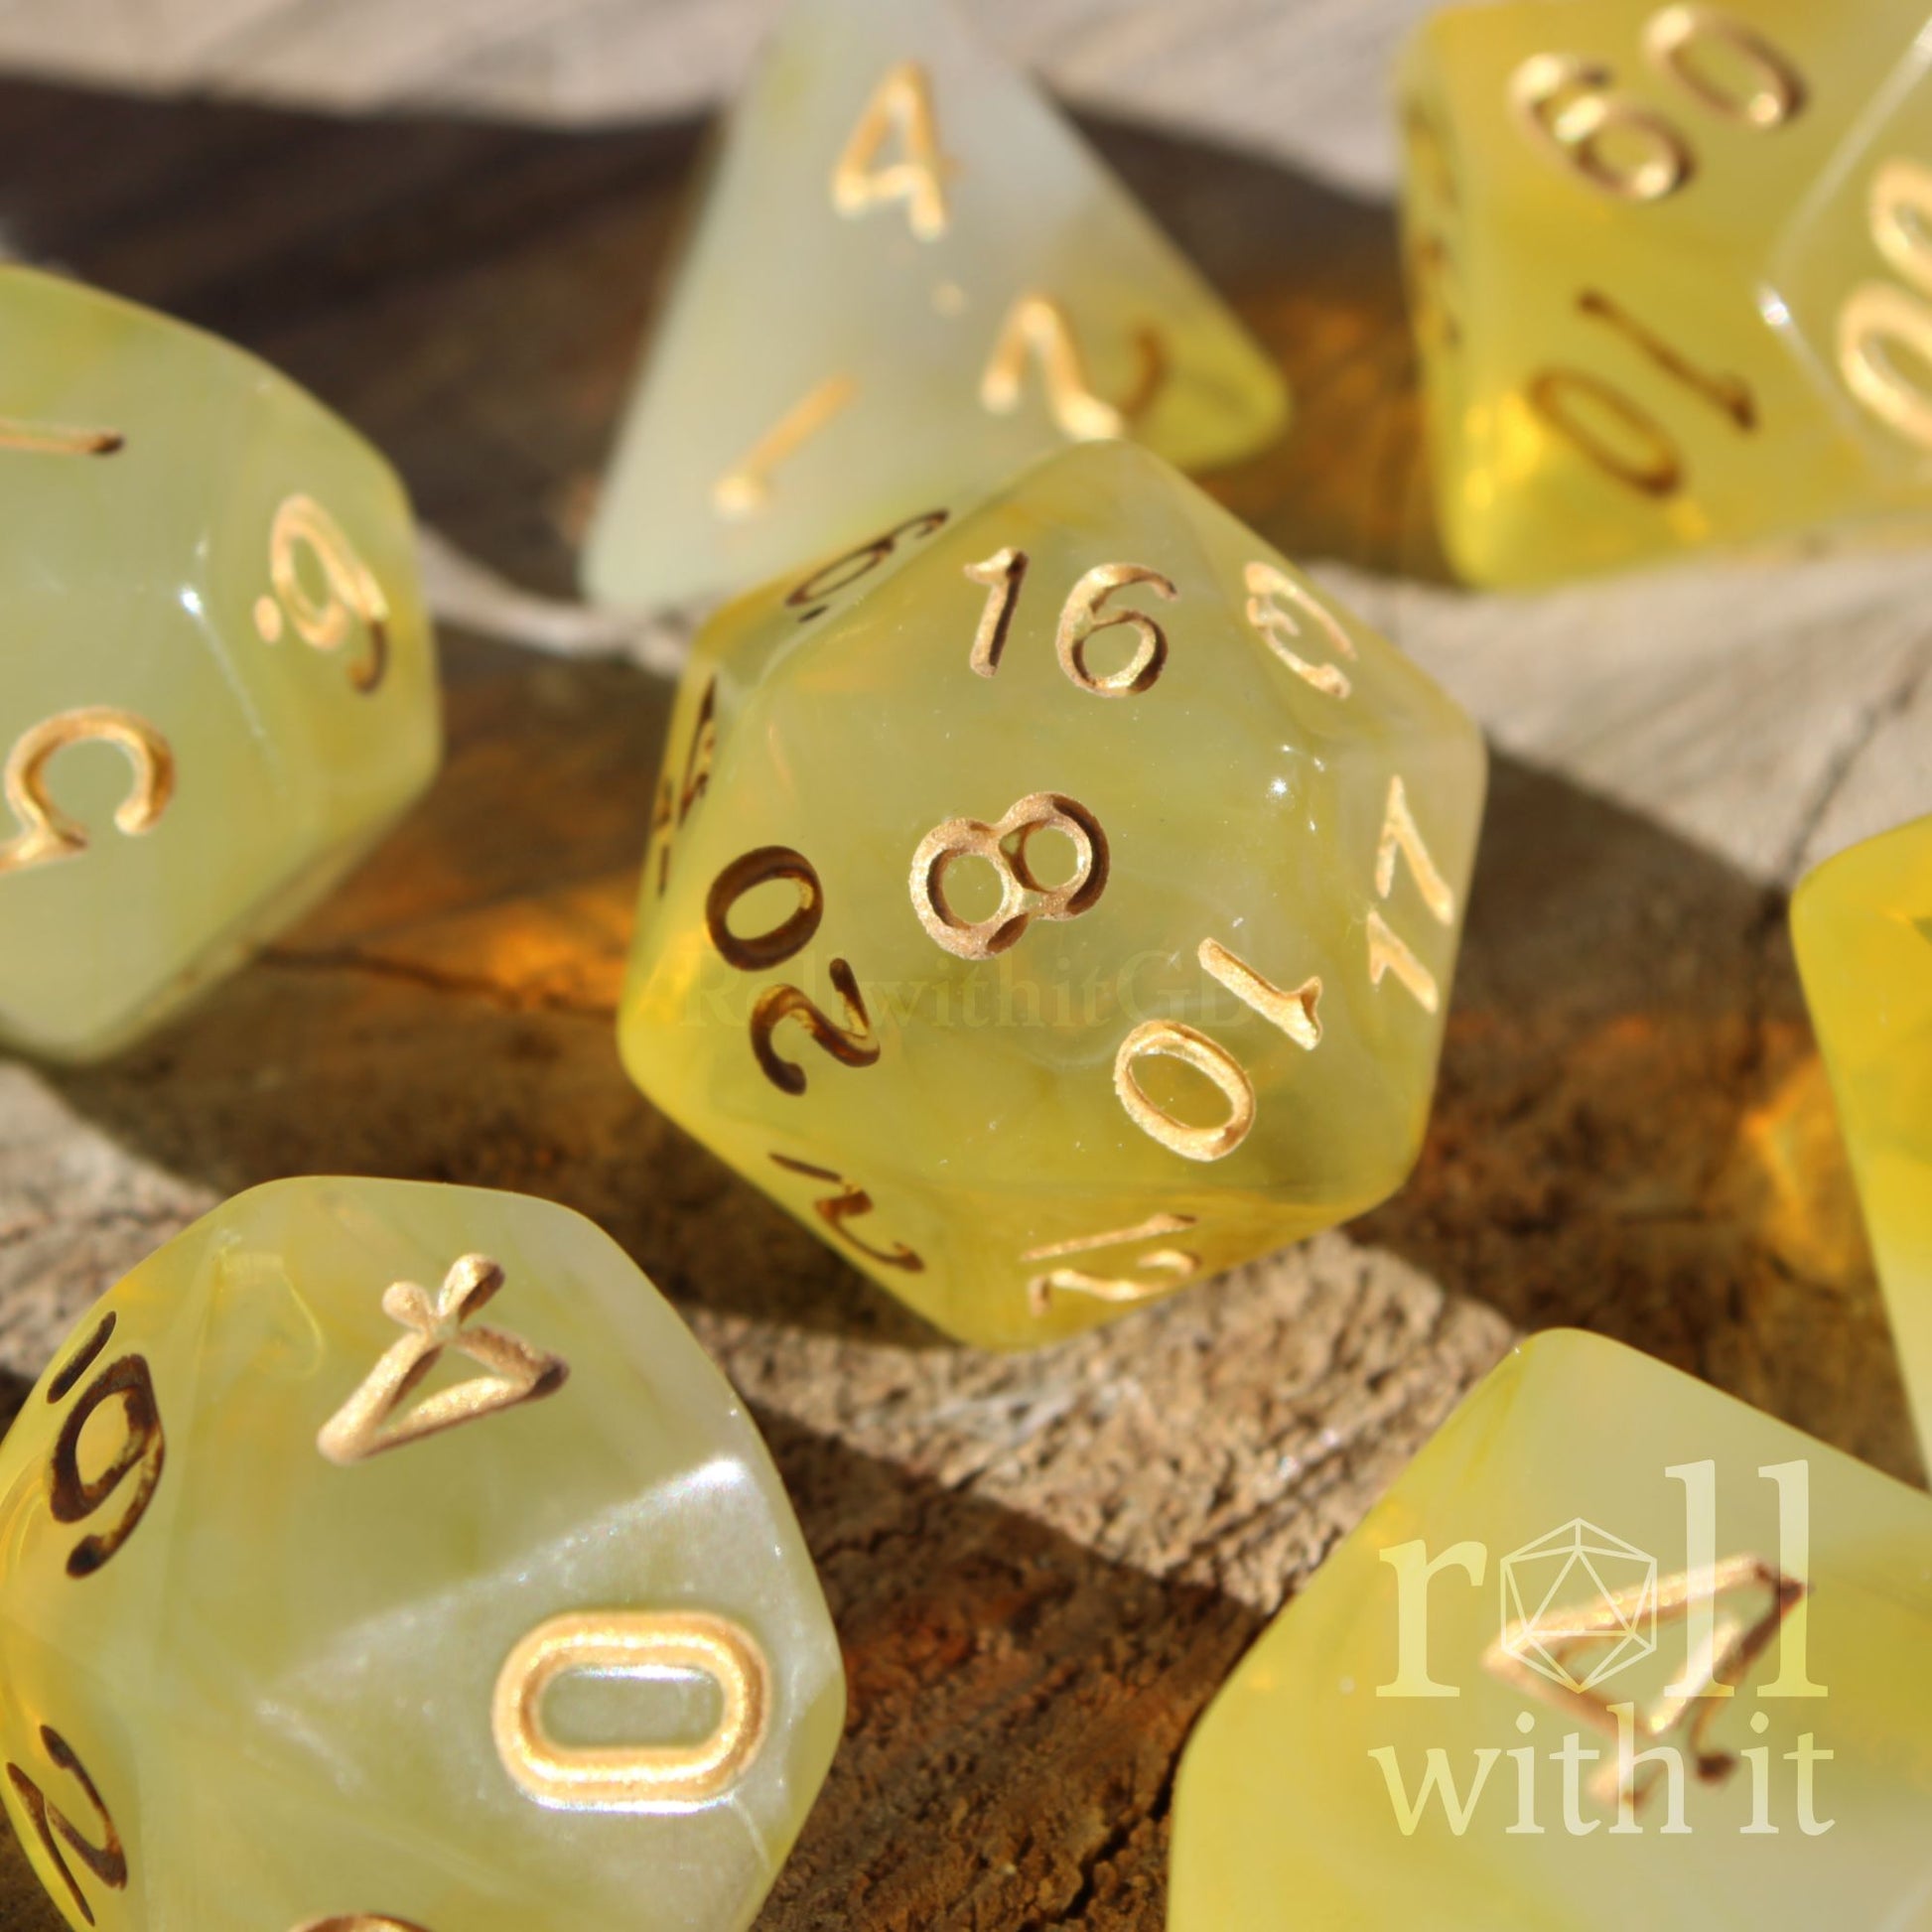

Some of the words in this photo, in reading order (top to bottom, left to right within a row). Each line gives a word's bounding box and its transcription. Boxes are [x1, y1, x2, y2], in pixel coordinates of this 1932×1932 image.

[963, 546, 1177, 698] 16
[706, 845, 882, 1097] 20
[908, 790, 1110, 960] 8
[1114, 937, 1324, 1163] 10
[316, 1252, 571, 1467] 4
[491, 1608, 772, 1809] 0
